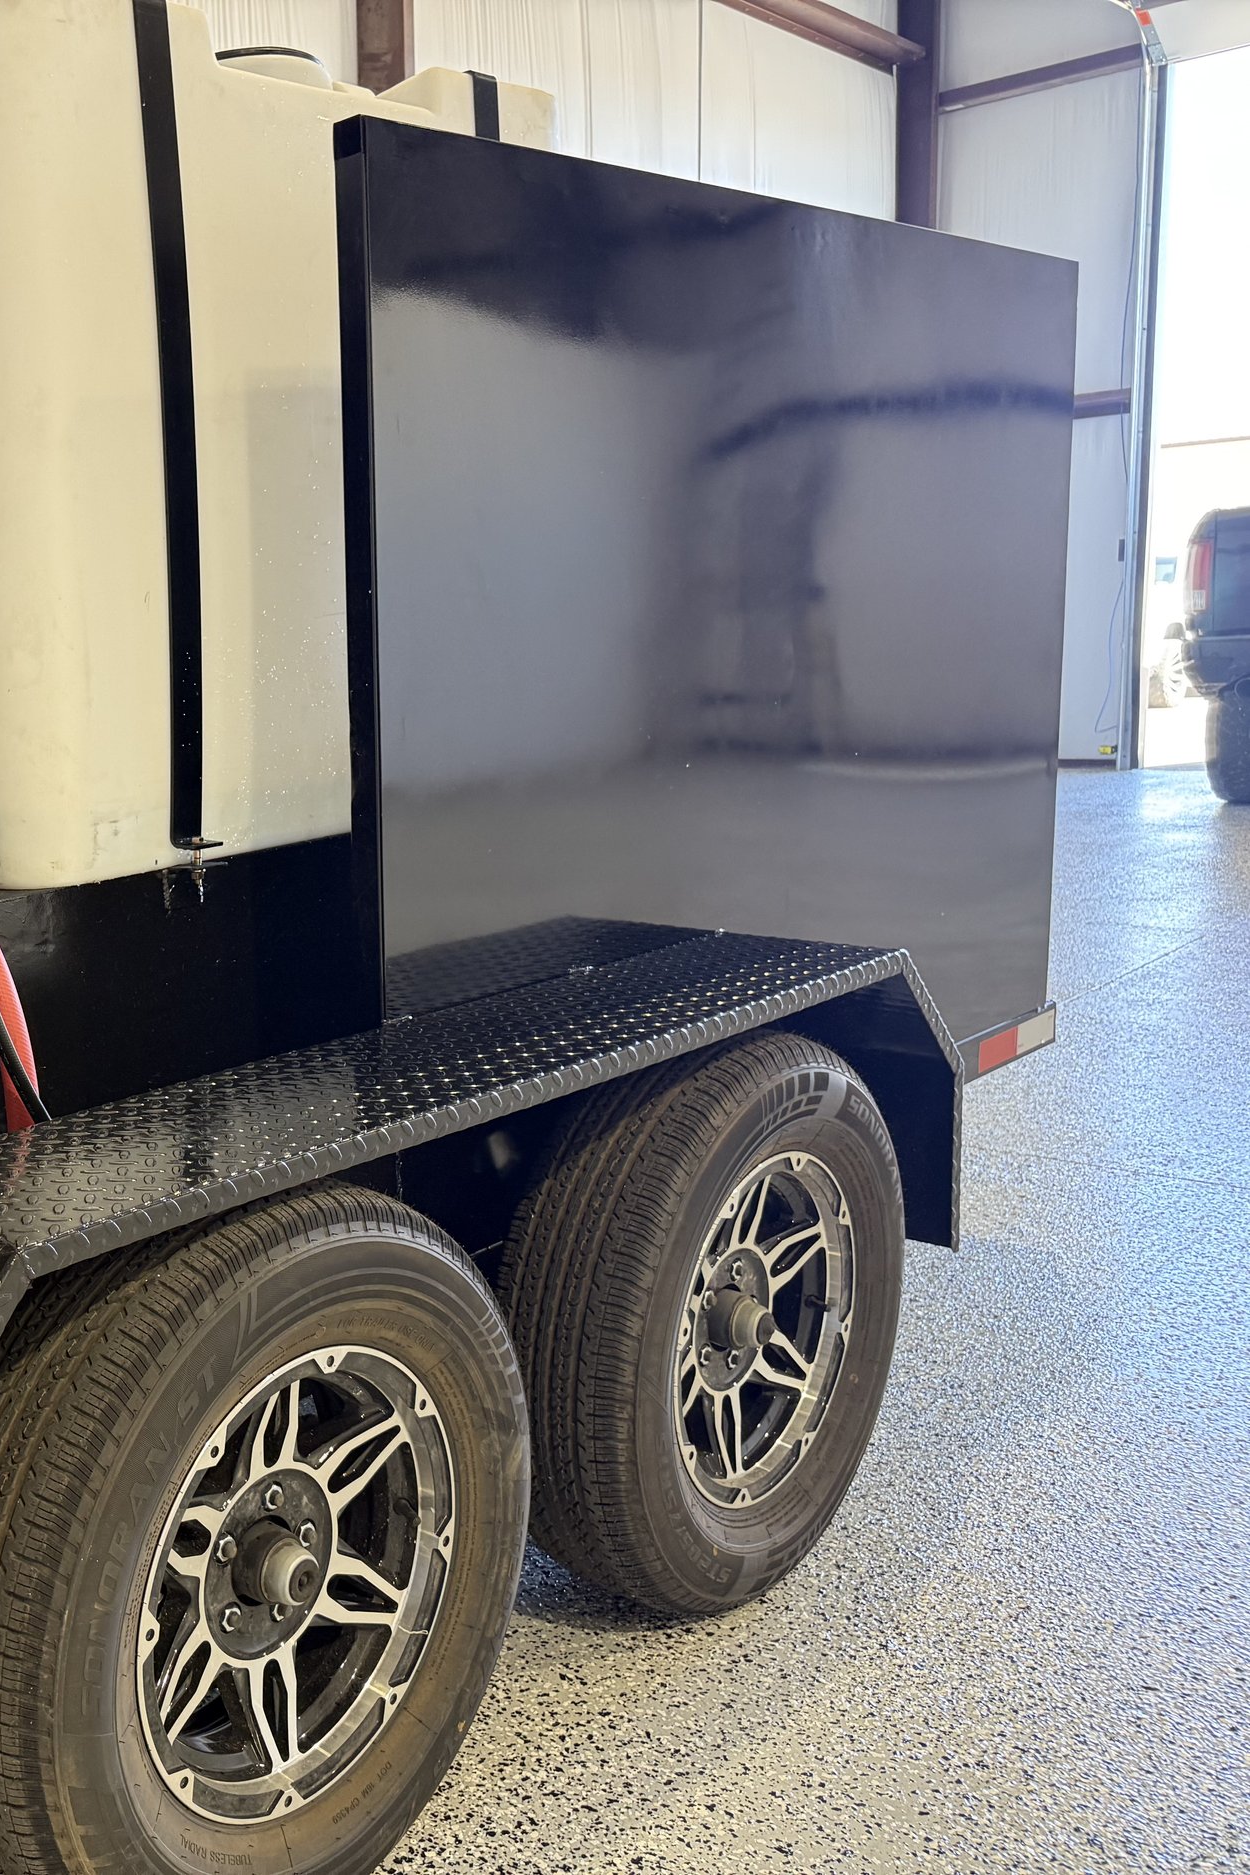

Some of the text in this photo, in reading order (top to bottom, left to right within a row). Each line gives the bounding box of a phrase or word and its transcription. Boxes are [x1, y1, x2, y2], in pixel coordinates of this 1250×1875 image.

[80, 1429, 175, 1718] SONORAN
[179, 1833, 253, 1867] TUBELESS RADIAL
